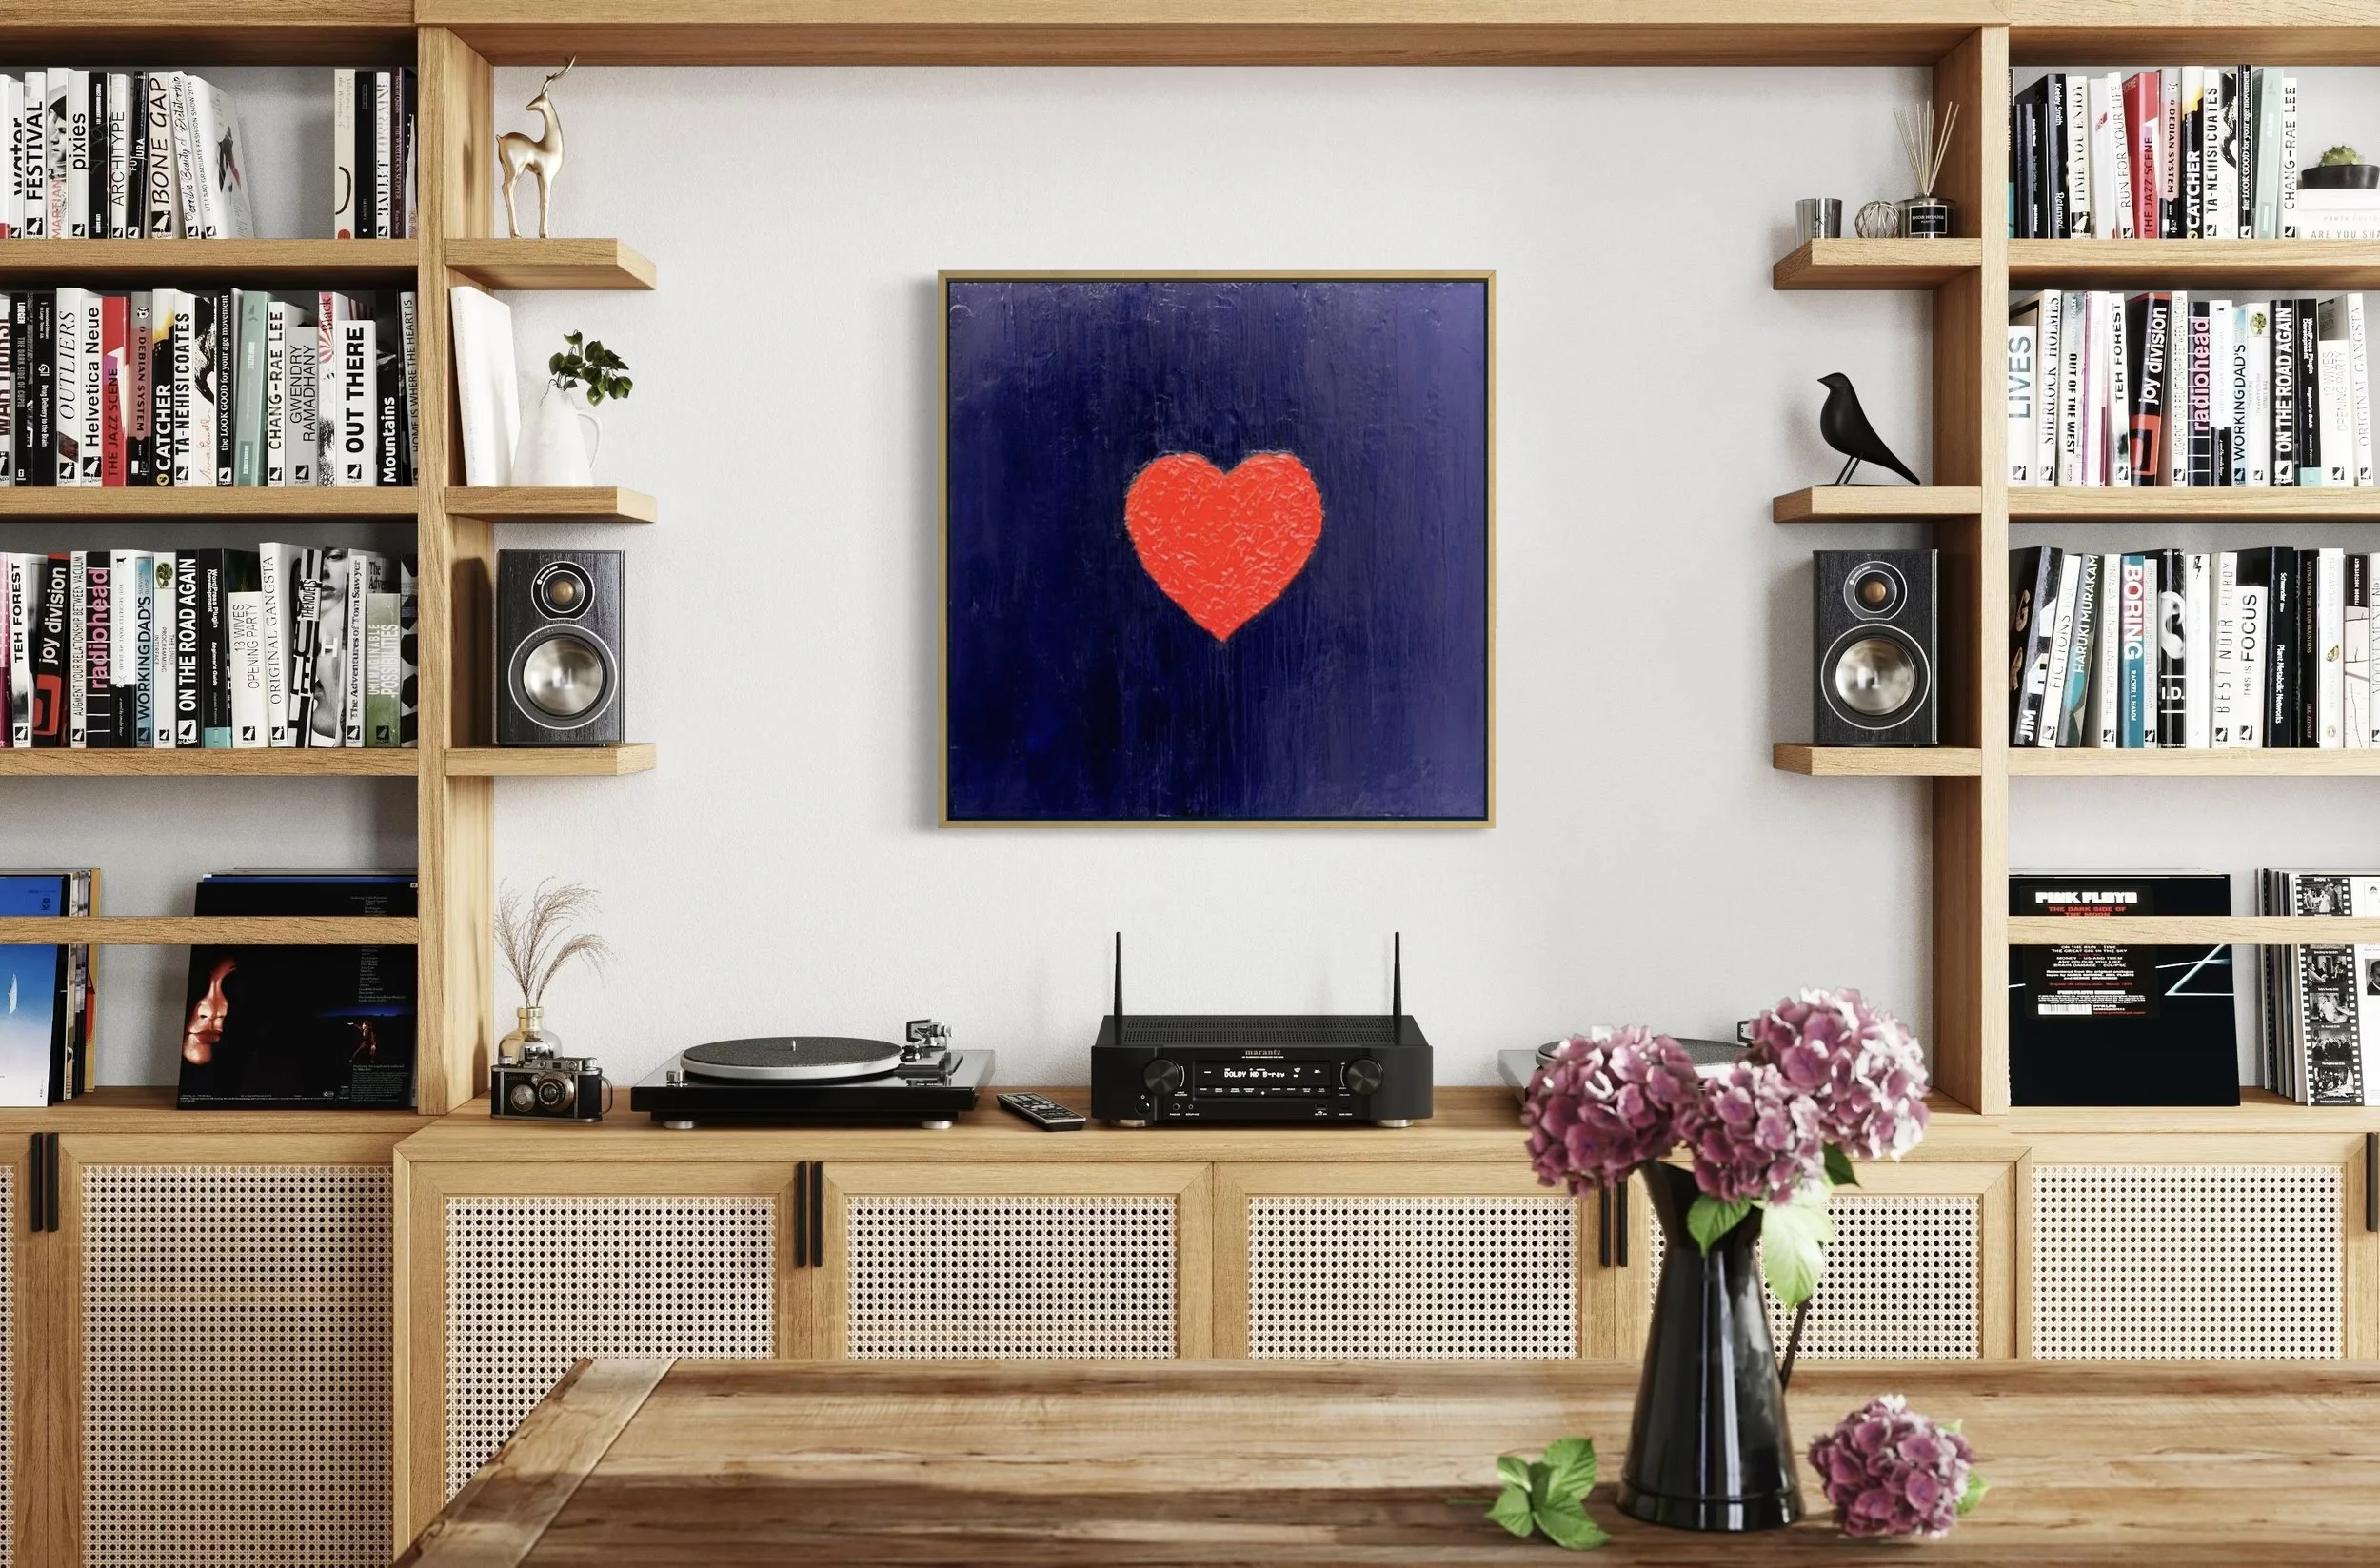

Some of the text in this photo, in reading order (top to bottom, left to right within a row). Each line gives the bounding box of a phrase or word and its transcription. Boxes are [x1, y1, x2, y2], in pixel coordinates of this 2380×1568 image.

[26, 101, 43, 200] FESTIVAL
[69, 113, 89, 169] pixies
[111, 111, 125, 207] ARCHITYPE
[149, 77, 169, 204] BONE GAP
[2073, 85, 2085, 202] TIME YOU ENJOY
[2111, 85, 2131, 207] RUN FOR YOUR LIFE
[2144, 136, 2153, 233] THE JAZZ SCENE
[2206, 88, 2218, 213] TA-NEHISI COATES
[2284, 87, 2296, 209] CHANG-RAE LEE
[51, 180, 62, 238] MARTIAN
[2054, 192, 2065, 230] Returned
[2186, 150, 2200, 228] CATCHER
[222, 336, 230, 350] age
[319, 297, 333, 330] Black
[404, 299, 412, 308] IS
[405, 311, 414, 345] HEART
[59, 310, 76, 420] OUTLIERS
[85, 307, 100, 447] Helvetica Neue
[136, 336, 147, 431] DEBIAN SYSTEM
[175, 312, 190, 455] TA-NEHISI COATES
[221, 351, 230, 370] your
[268, 311, 283, 450] CHANG-RAE LEE
[289, 345, 302, 423] GWENDRY
[303, 345, 316, 441] RAMADHANY
[346, 327, 364, 453] OUT THERE
[406, 346, 416, 367] THE
[407, 369, 418, 407] WHERE
[2008, 336, 2031, 418] LIVES
[2041, 297, 2059, 445] SHERLOCK HOLMES
[2068, 379, 2077, 393] OF
[2069, 353, 2078, 376] OUT
[2112, 303, 2124, 402] TEH FOREST
[2138, 307, 2167, 405] joy division
[2190, 317, 2210, 431] radiohead
[2275, 308, 2292, 452] ON THE ROAD AGAIN
[108, 368, 119, 477] THE JAZZ SCENE
[156, 384, 171, 471] CATCHER
[381, 397, 396, 482] Mountains
[2066, 421, 2077, 454] WEST
[2067, 397, 2077, 419] THE
[11, 562, 23, 663] TEH FOREST
[39, 567, 66, 665] joy division
[73, 556, 84, 716] AUGMENT YOUR RELATIONSHIP BETWEEN VACUUM
[89, 568, 109, 689] radiohead
[178, 558, 196, 711] ON THE ROAD AGAIN
[233, 604, 245, 652] 13 WIVES
[246, 604, 260, 688] OPENING PARTY
[263, 556, 282, 704] ORIGINAL GANGSTA
[301, 579, 317, 619] THE NOVELS
[350, 560, 362, 720] The Adventures of Tom Sawyer
[2123, 565, 2143, 660] BORING
[2215, 562, 2233, 713] BEST NOIR ELLROY
[2240, 594, 2257, 696] THIS IS FOCUS
[368, 625, 380, 695] UNIMAGINABLE
[381, 624, 399, 695] POSSIBILITIES
[2073, 625, 2090, 673] HARUKI
[2161, 686, 2185, 700] I.D.
[2275, 645, 2285, 724] Plant Metabolic Networks
[2019, 709, 2037, 741] JIM
[2035, 891, 2138, 904] PINK FLOYD
